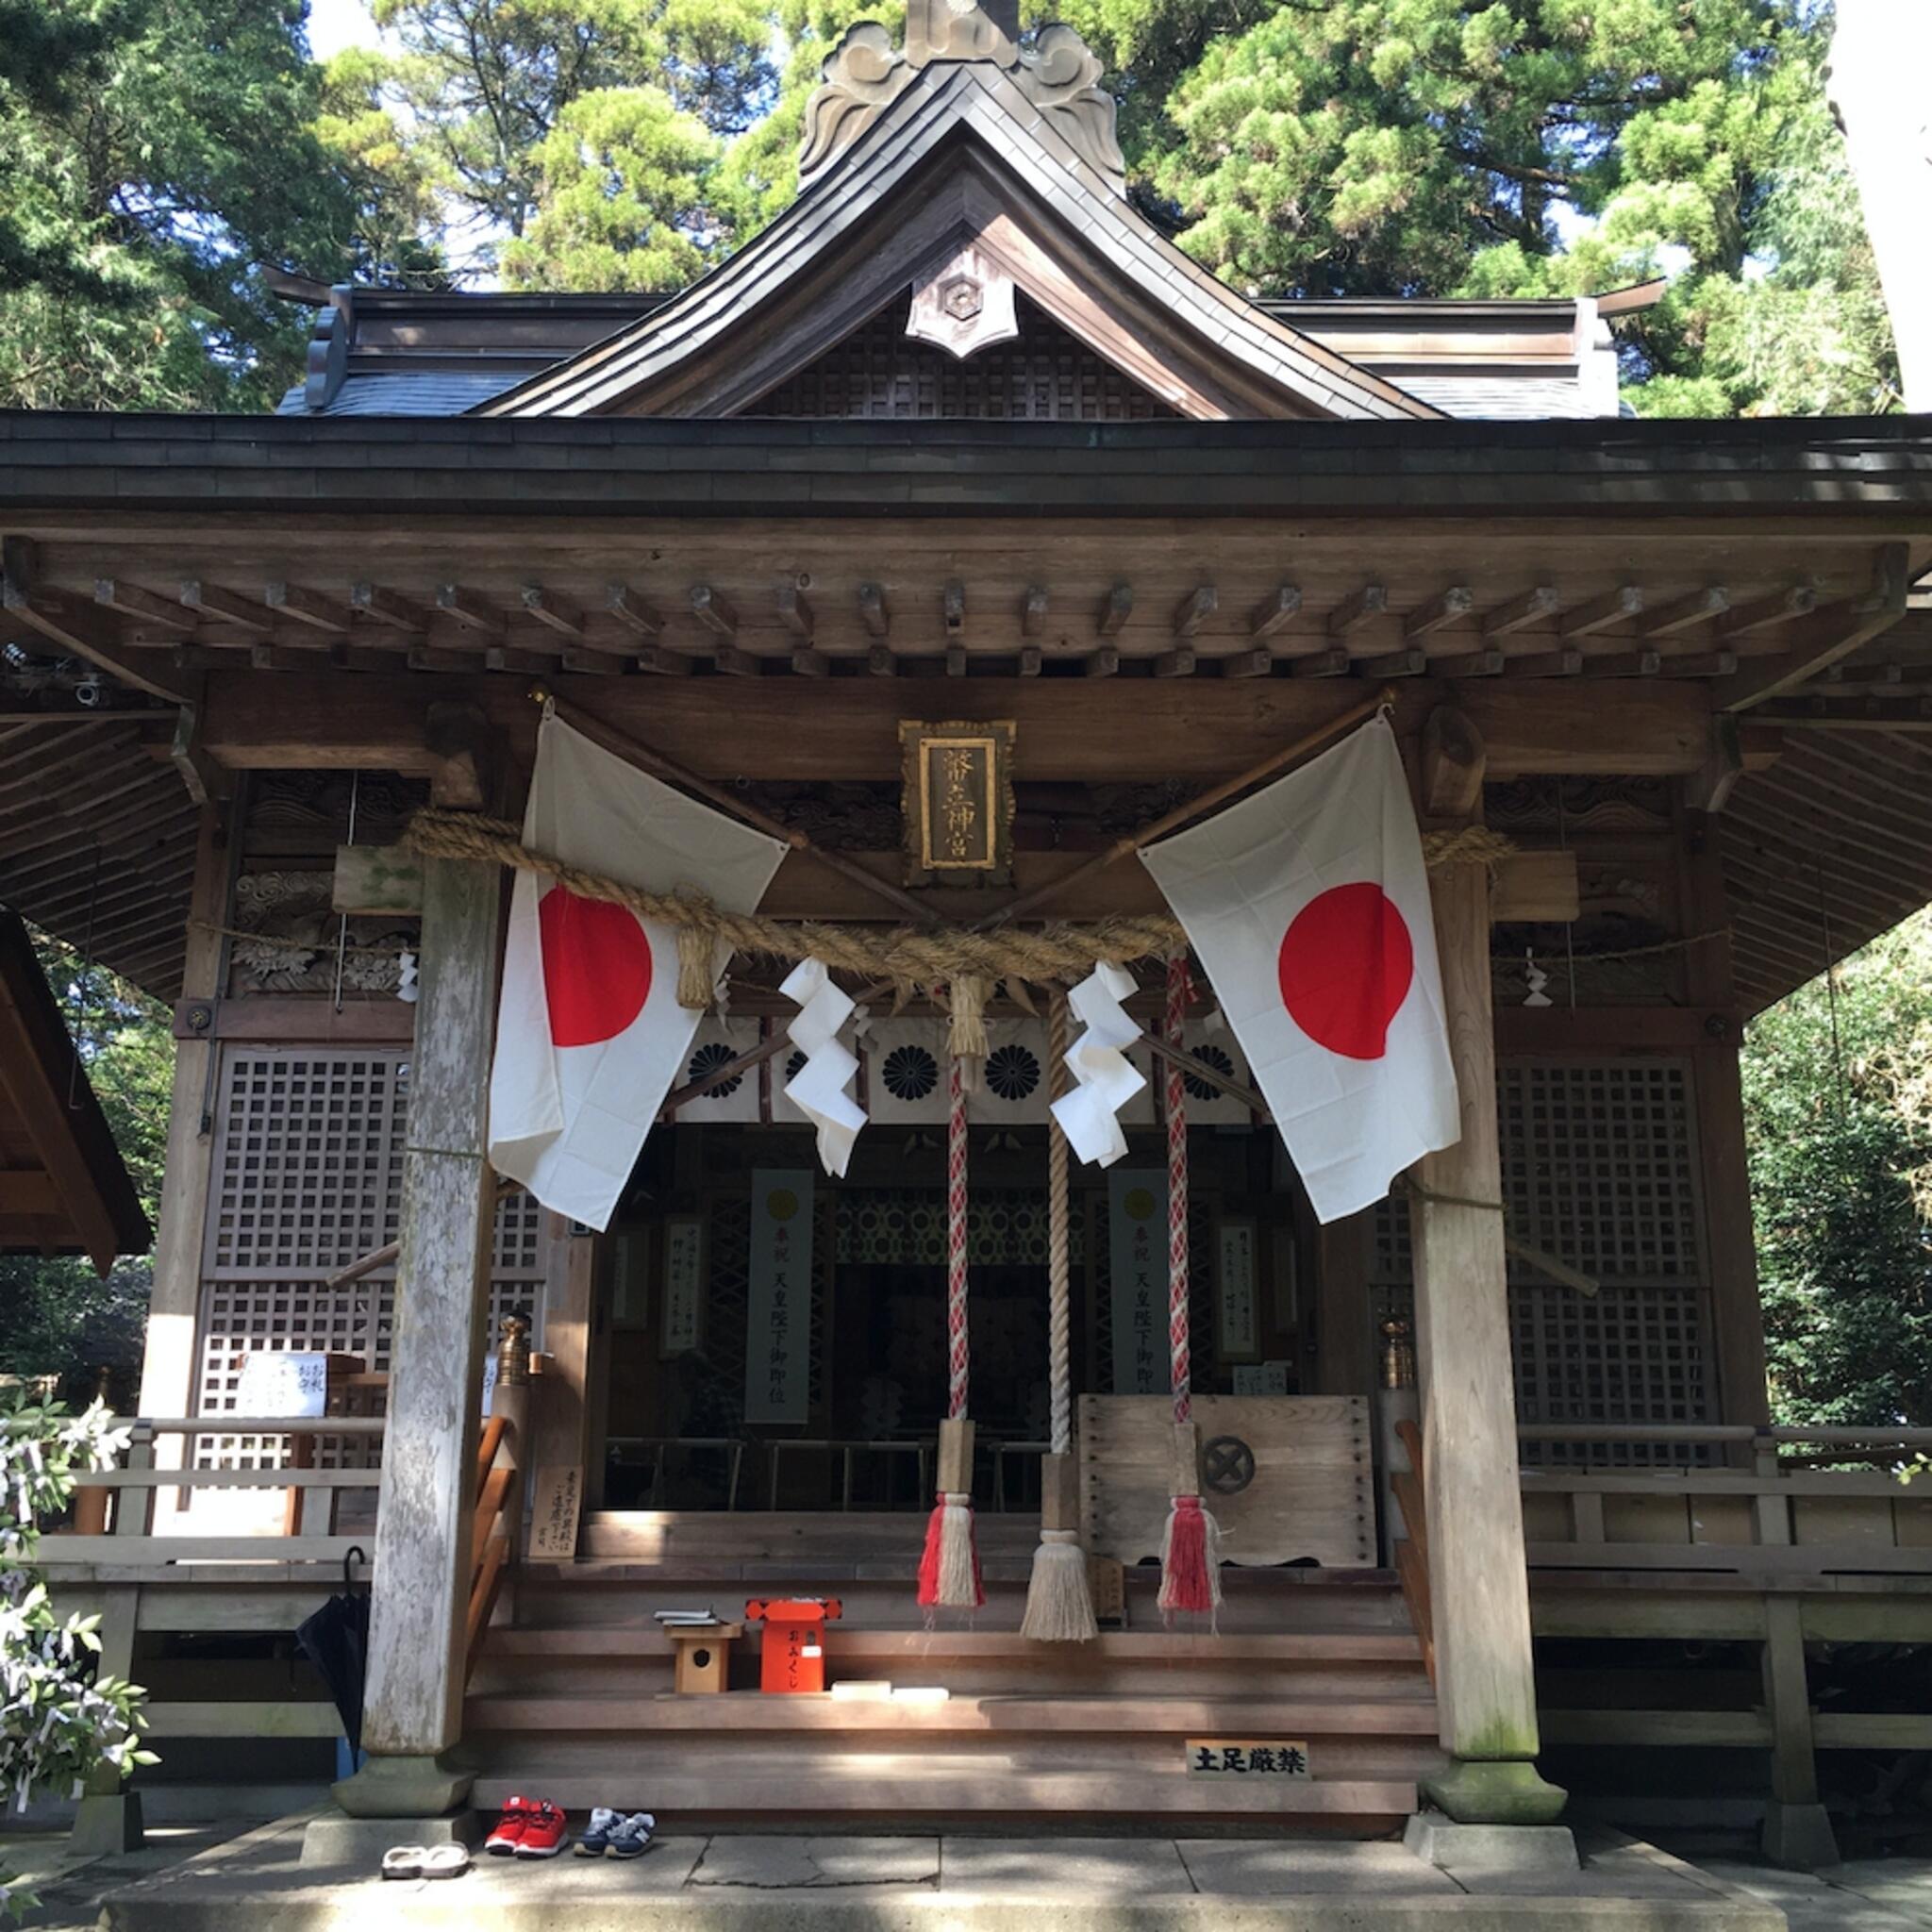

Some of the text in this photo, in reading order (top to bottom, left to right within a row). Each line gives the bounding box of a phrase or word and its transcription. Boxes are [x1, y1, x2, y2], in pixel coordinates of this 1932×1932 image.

[769, 1272, 789, 1404] 天皇陛下御即位
[1134, 1272, 1153, 1393] 天皇陛下御即
[788, 1629, 799, 1690] おみくじ
[1193, 1746, 1306, 1774] 土足厳禁
